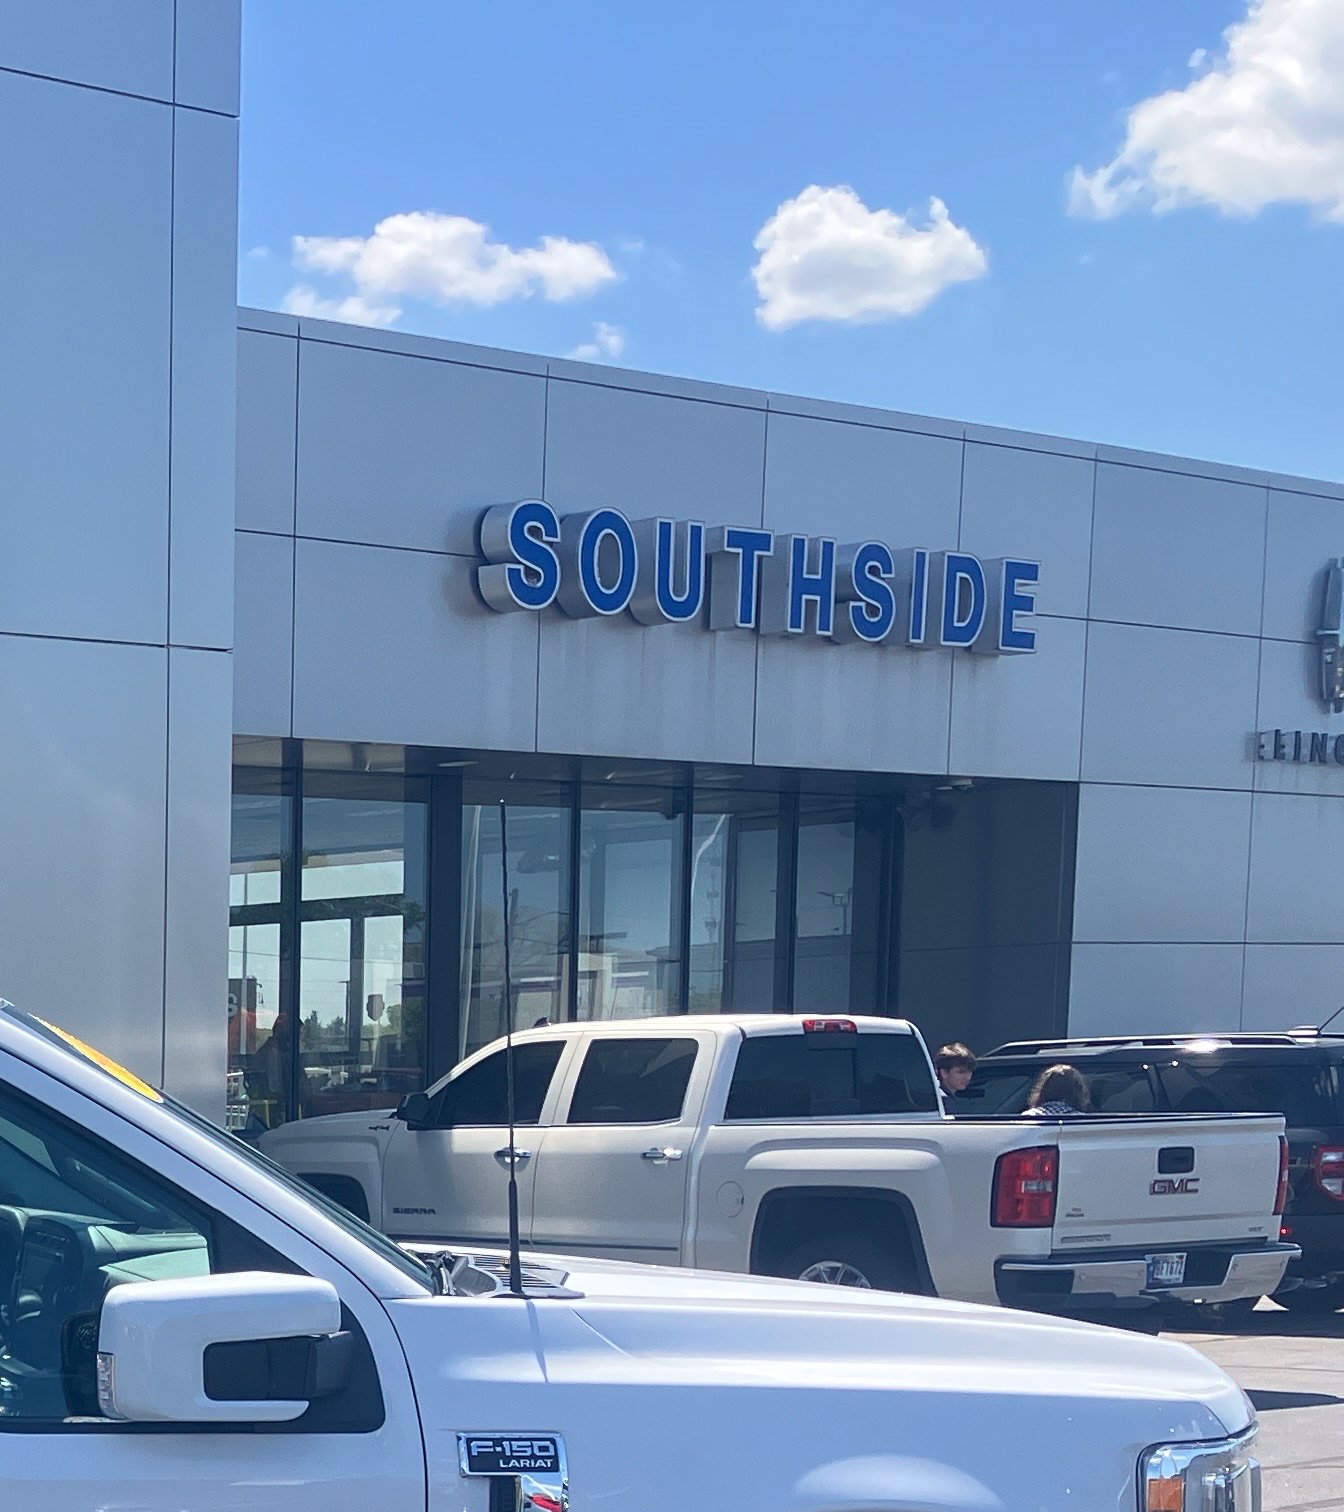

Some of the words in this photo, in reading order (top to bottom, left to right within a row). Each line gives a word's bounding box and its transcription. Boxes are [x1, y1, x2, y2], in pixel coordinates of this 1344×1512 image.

[484, 498, 1042, 654] SOUTHSIDE
[1150, 1178, 1200, 1196] GMC
[470, 1440, 555, 1456] F-150
[499, 1458, 554, 1468] LARIAT
